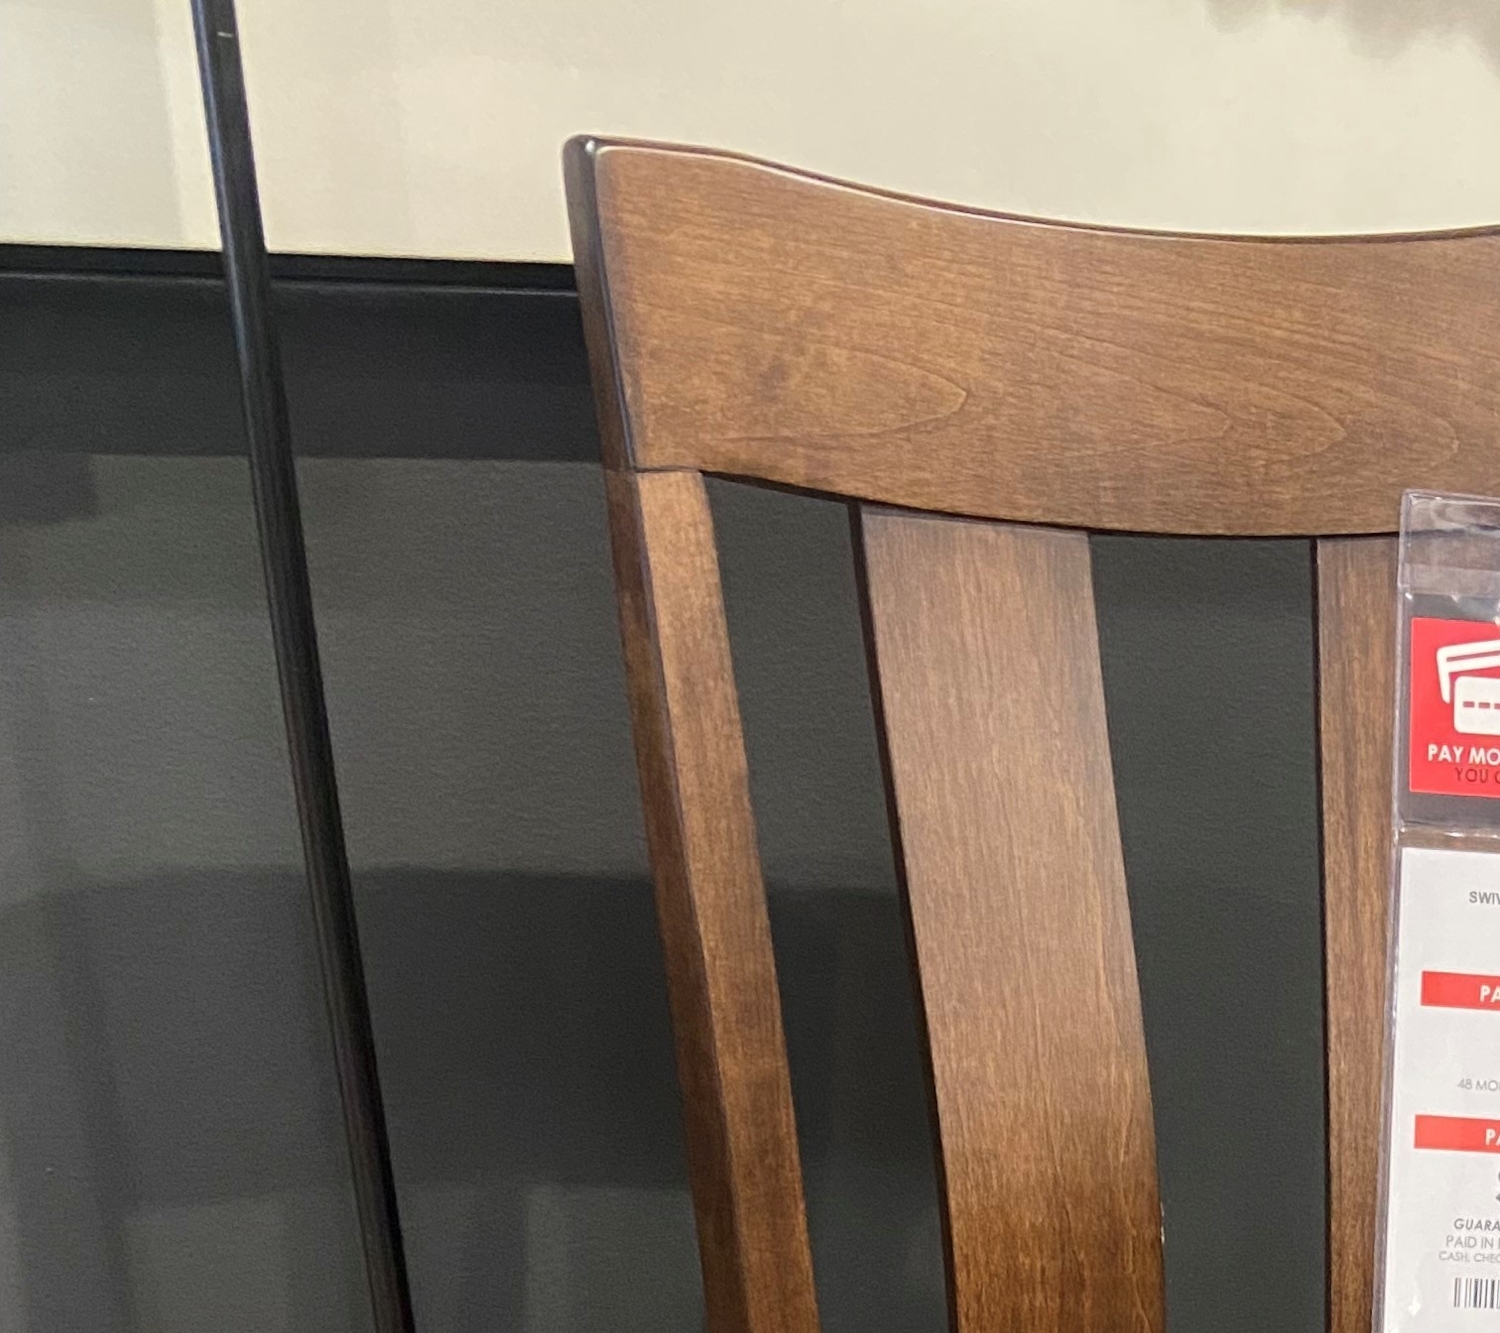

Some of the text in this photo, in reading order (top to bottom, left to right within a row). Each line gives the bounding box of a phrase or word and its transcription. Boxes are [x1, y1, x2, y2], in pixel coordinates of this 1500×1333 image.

[1428, 744, 1464, 763] PAY
[1455, 766, 1489, 783] YOU
[1457, 1078, 1473, 1090] 48
[1446, 1235, 1477, 1248] PAID
[1481, 1237, 1494, 1249] IN
